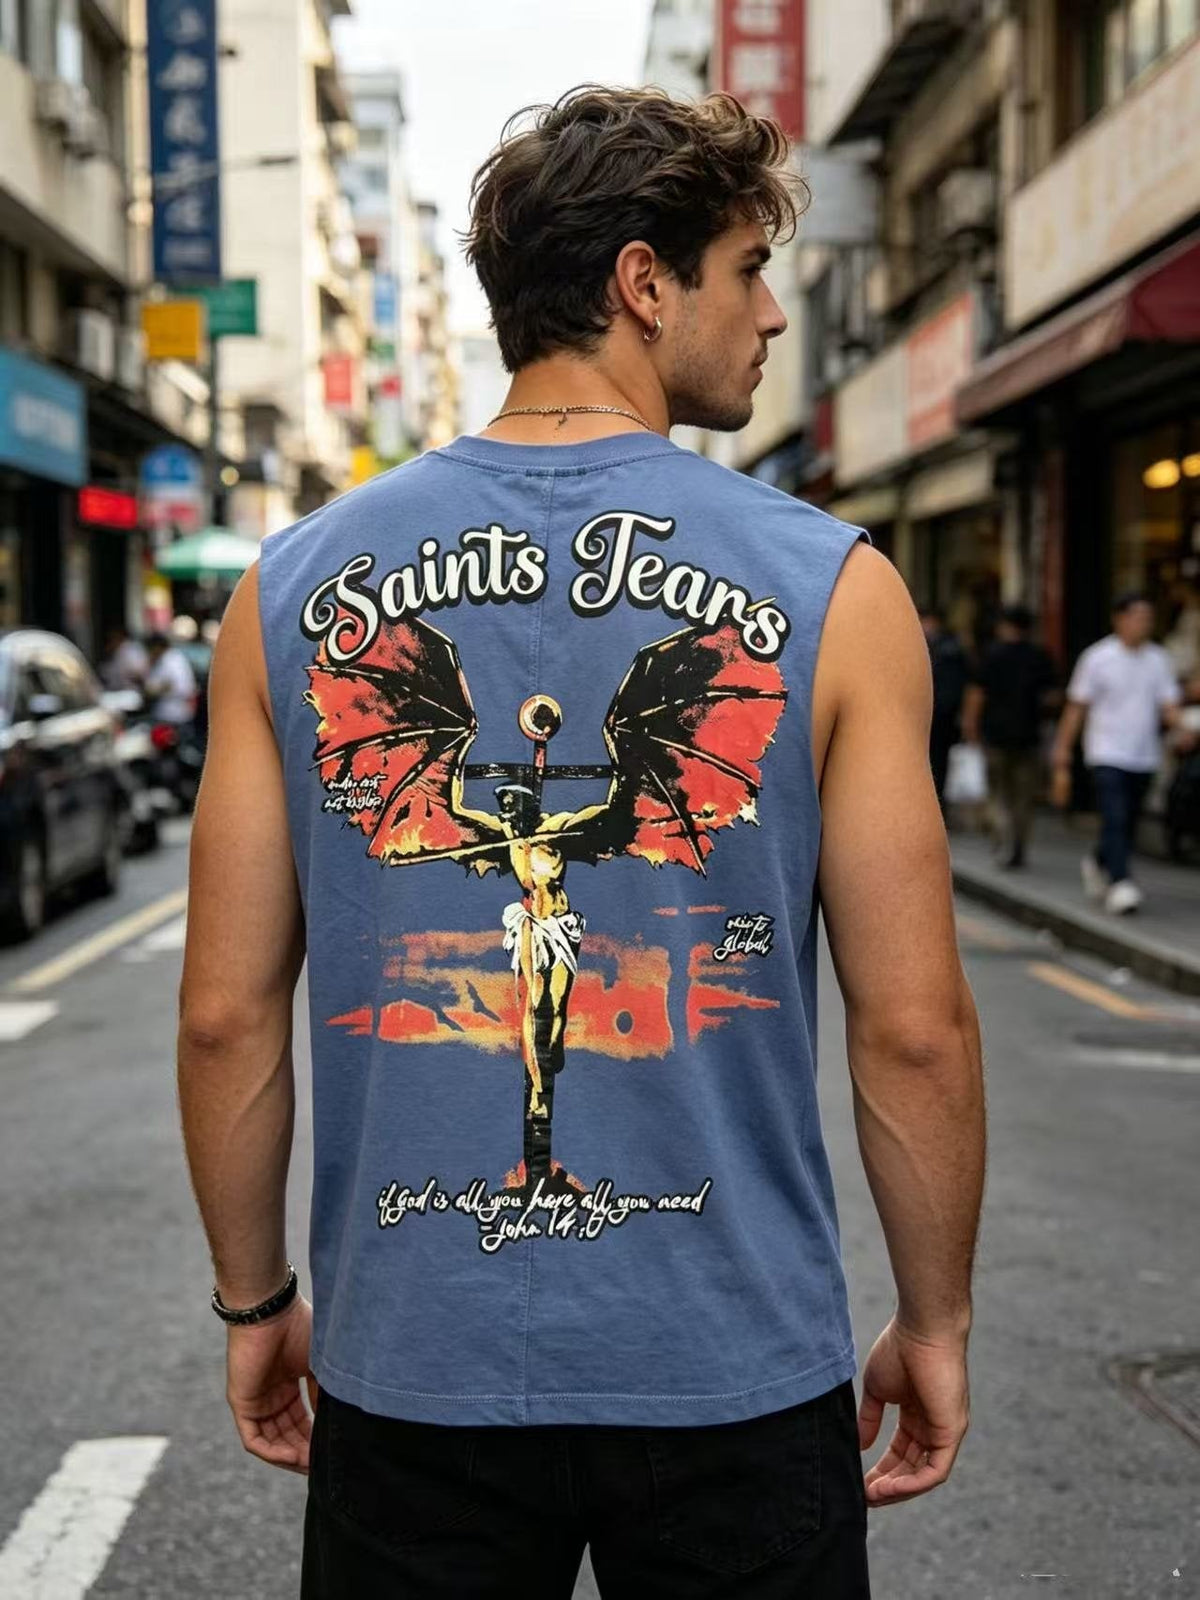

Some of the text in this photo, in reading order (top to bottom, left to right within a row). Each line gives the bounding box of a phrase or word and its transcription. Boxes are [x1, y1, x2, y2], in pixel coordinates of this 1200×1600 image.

[302, 510, 790, 662] Saints Tears
[713, 928, 772, 960] global
[378, 1182, 398, 1227] if
[432, 1191, 449, 1210] is
[454, 1180, 487, 1213] all
[477, 1194, 522, 1223] you
[525, 1177, 578, 1213] have
[580, 1180, 613, 1214] all
[607, 1196, 651, 1224] you
[657, 1180, 711, 1213] need
